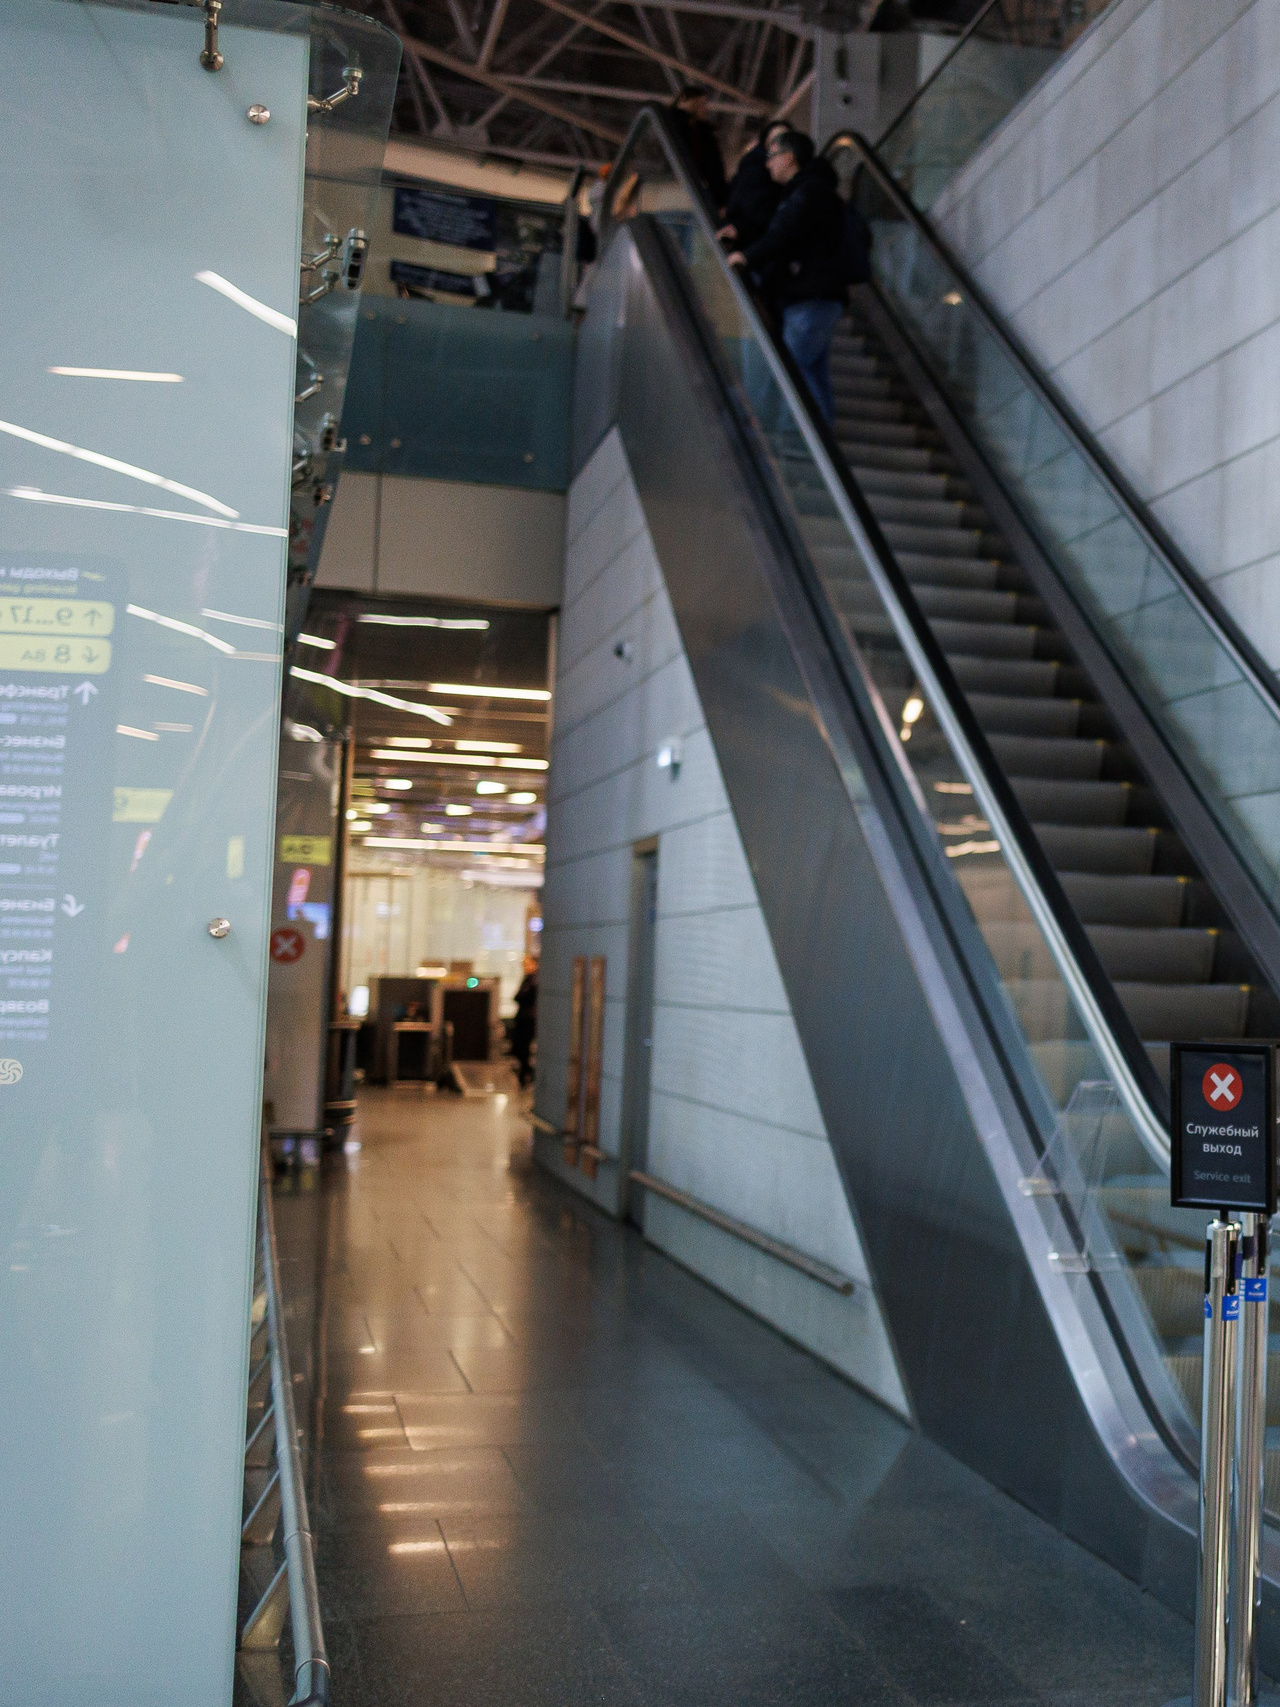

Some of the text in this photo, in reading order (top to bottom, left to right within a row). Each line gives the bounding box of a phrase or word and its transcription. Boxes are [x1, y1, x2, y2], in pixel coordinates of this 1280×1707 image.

[1186, 1123, 1259, 1138] Служебный
[1203, 1143, 1242, 1156] выход
[1194, 1170, 1251, 1183] Service exit
